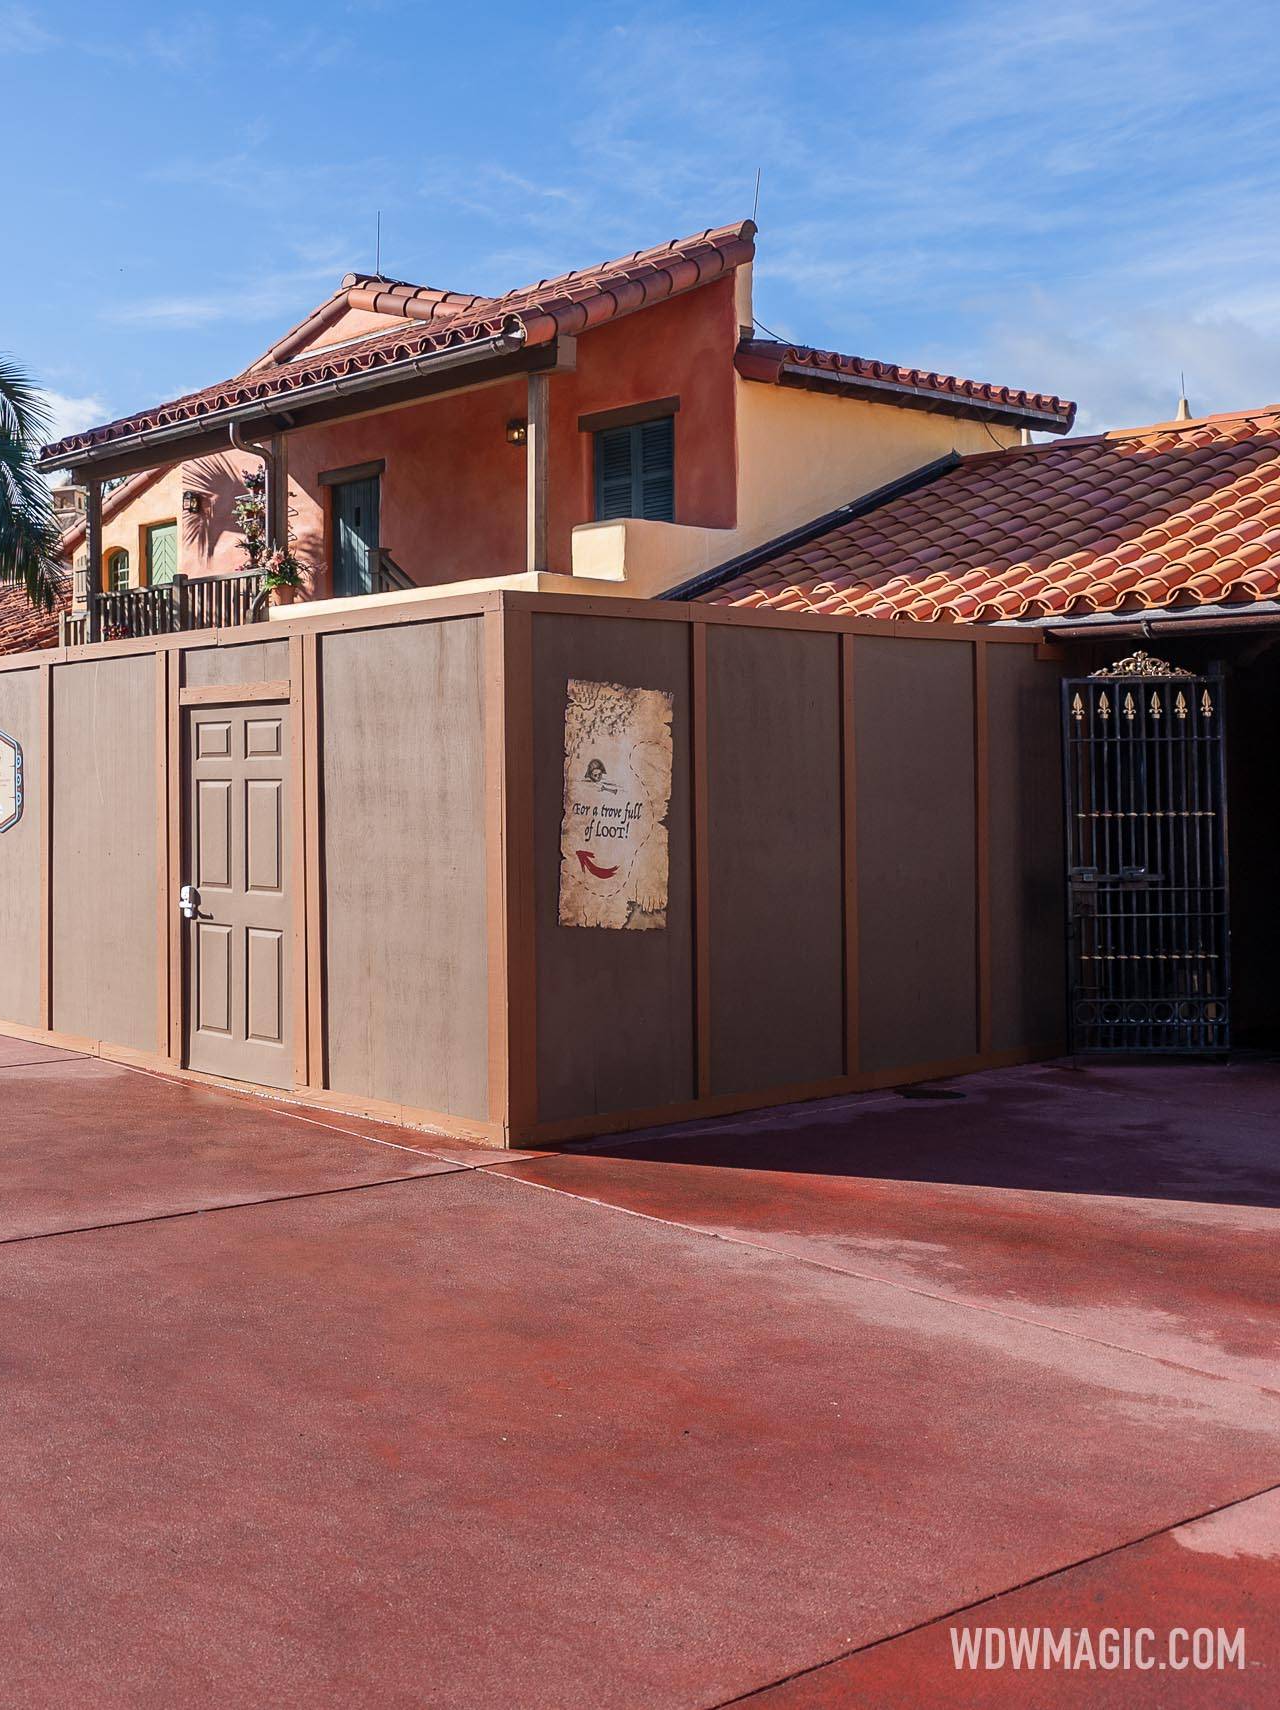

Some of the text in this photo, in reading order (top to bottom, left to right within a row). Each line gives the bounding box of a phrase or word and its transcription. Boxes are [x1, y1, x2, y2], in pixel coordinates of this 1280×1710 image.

[572, 801, 643, 824] For a trove full
[584, 819, 595, 842] of
